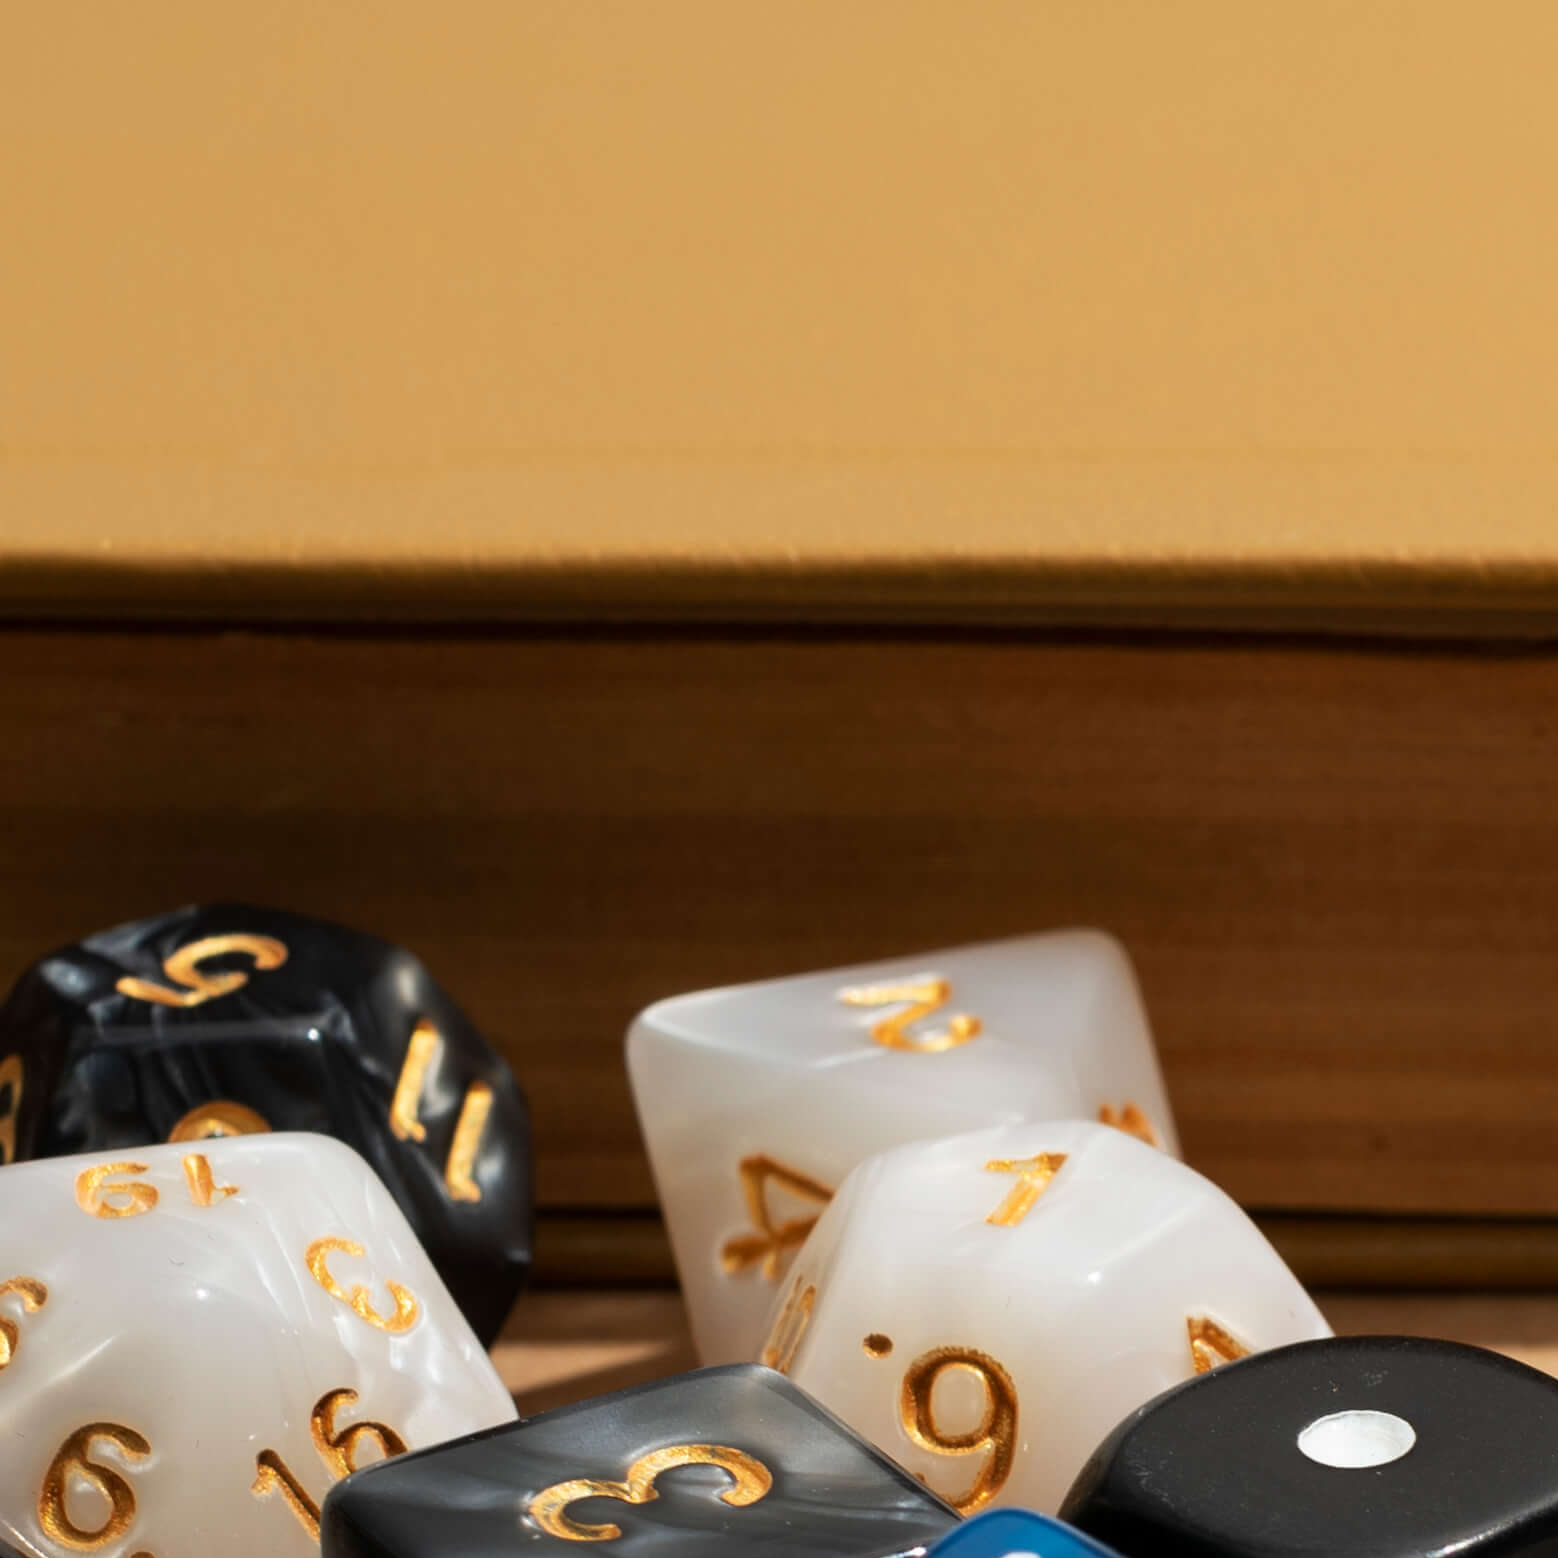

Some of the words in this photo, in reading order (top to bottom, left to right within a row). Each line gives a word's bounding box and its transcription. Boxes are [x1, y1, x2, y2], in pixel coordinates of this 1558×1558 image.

[117, 933, 288, 1006] 5
[304, 1236, 419, 1332] 3
[528, 1444, 774, 1542] 3
